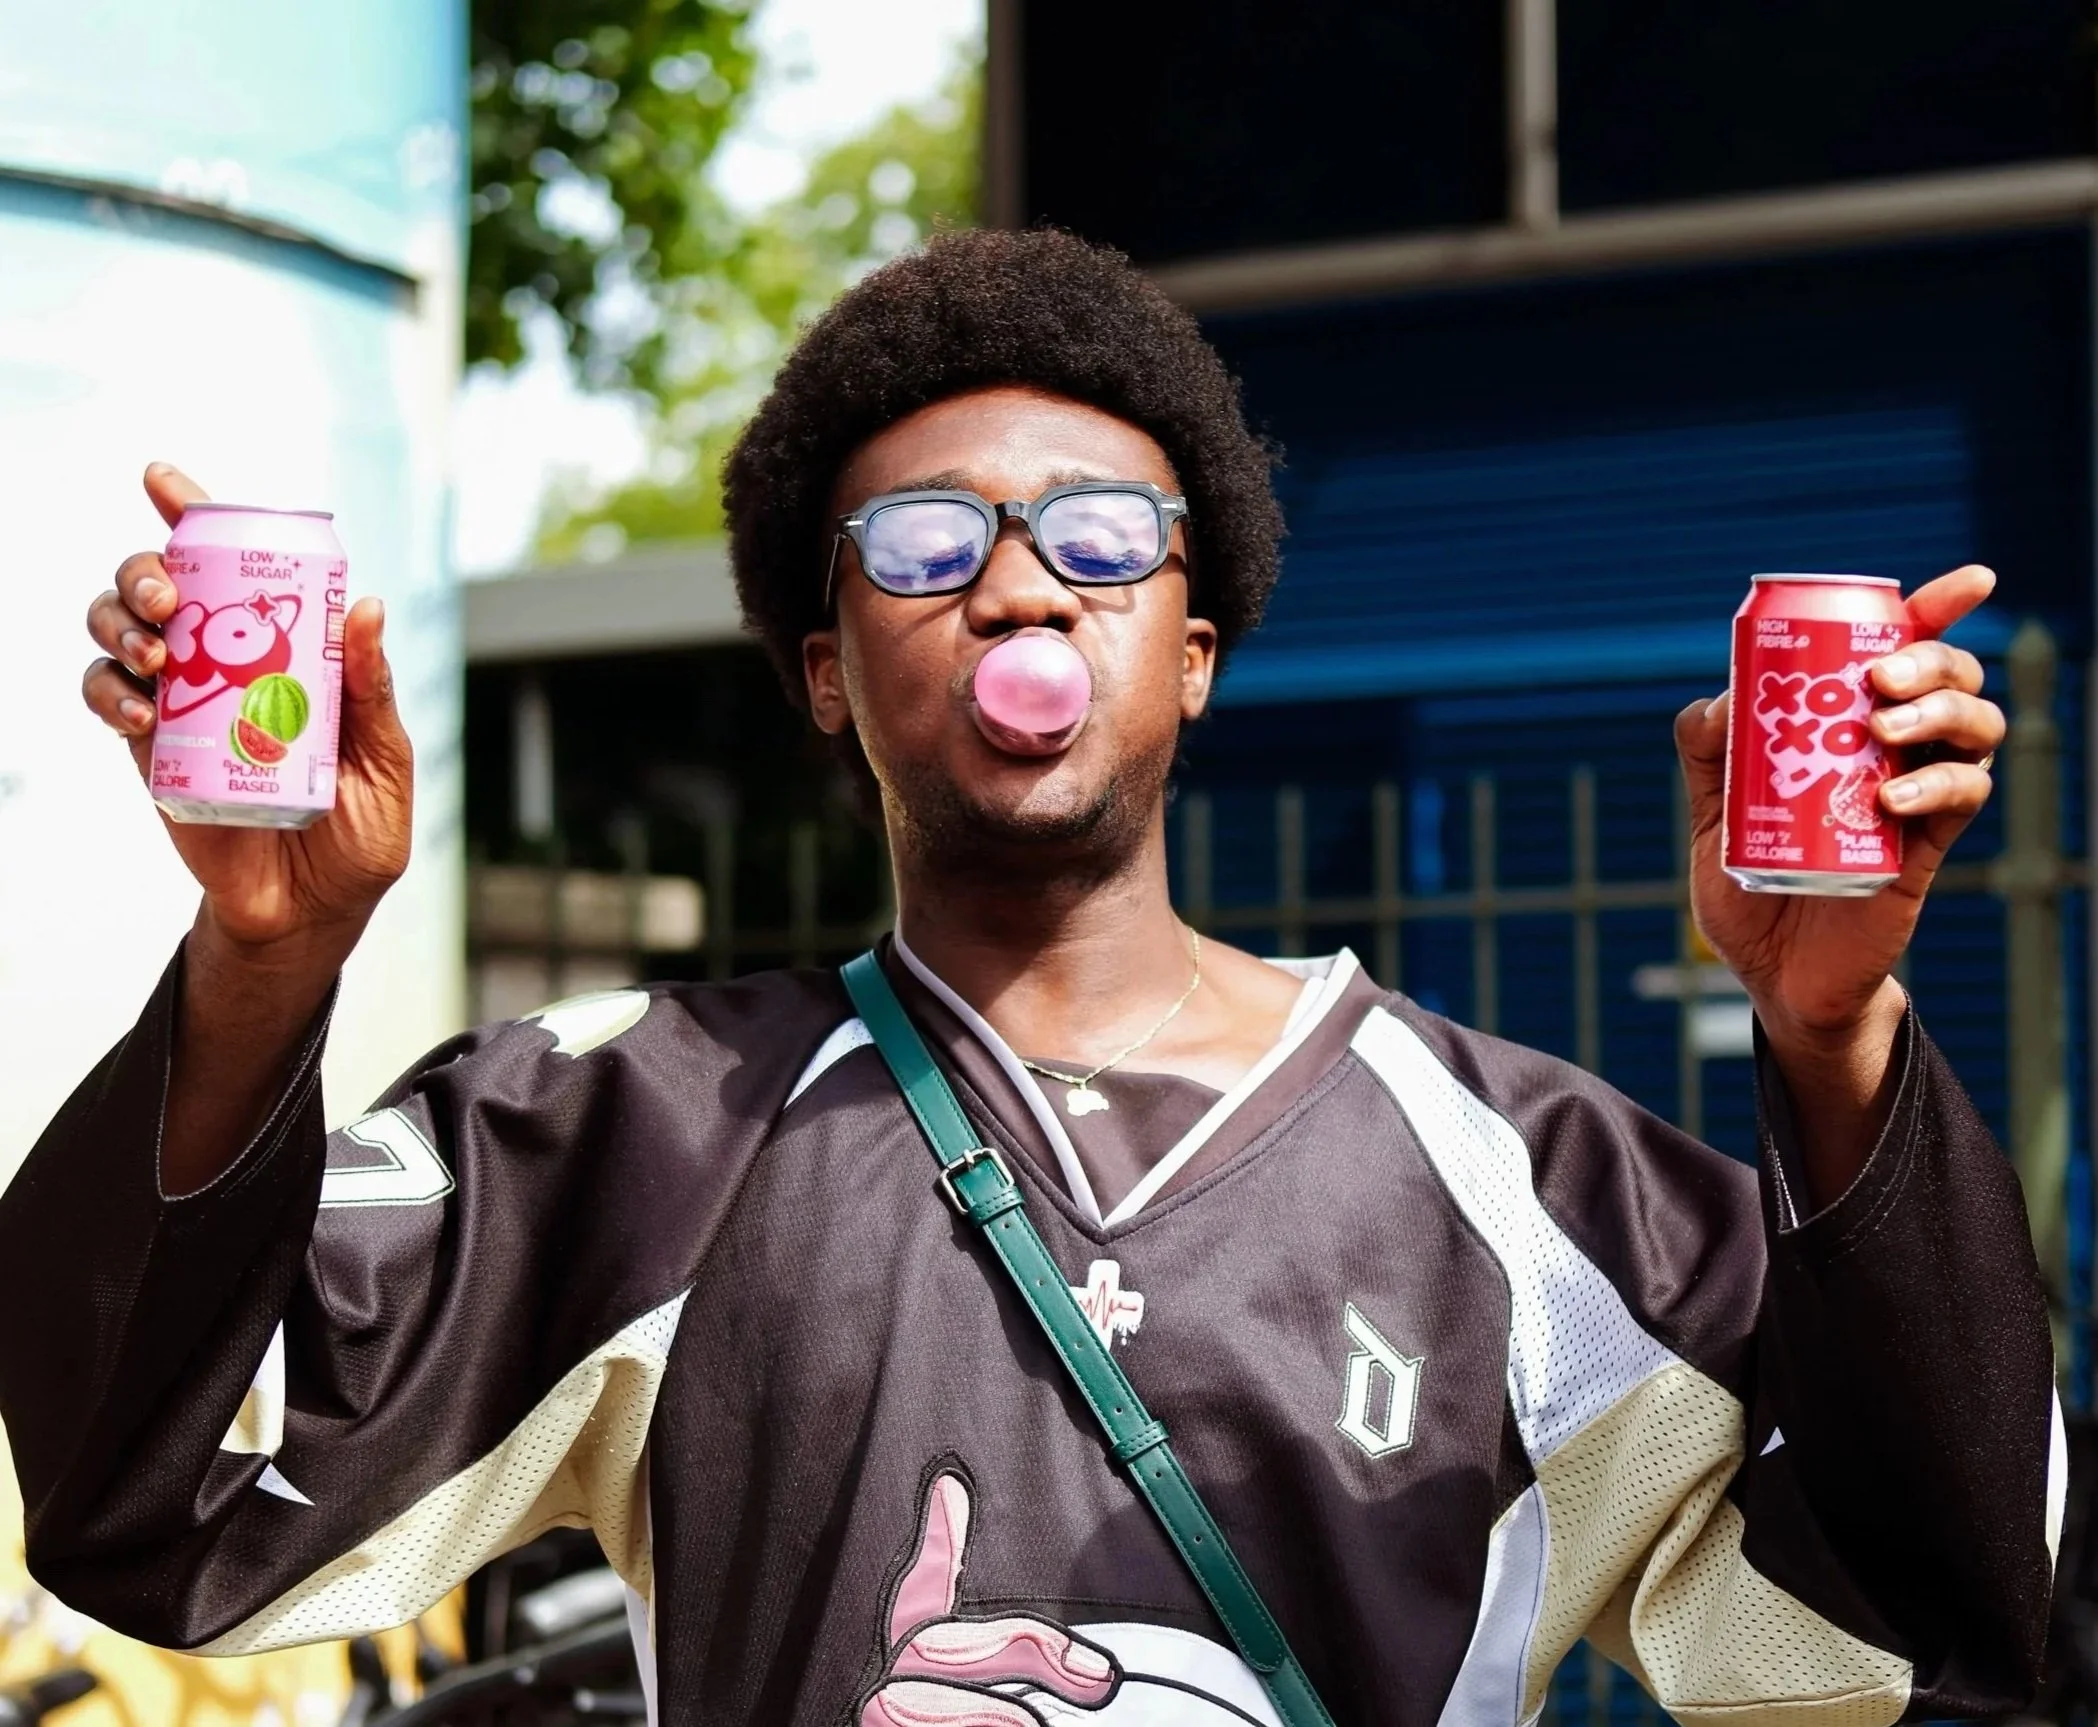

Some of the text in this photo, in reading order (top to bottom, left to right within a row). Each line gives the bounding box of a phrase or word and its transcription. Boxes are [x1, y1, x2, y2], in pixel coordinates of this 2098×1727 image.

[241, 550, 275, 564] LOW
[240, 565, 292, 580] SUGAR
[1757, 620, 1789, 634] HIGH
[1851, 622, 1884, 637] LOW
[1757, 635, 1794, 649] FIBRE
[1850, 637, 1895, 653] SUGAR
[229, 764, 280, 778] PLANT
[228, 779, 280, 793] BASED
[1746, 830, 1775, 845] LOW
[1841, 834, 1884, 849] PLANT
[1745, 846, 1804, 861] CALORIE
[1840, 850, 1884, 865] BASED
